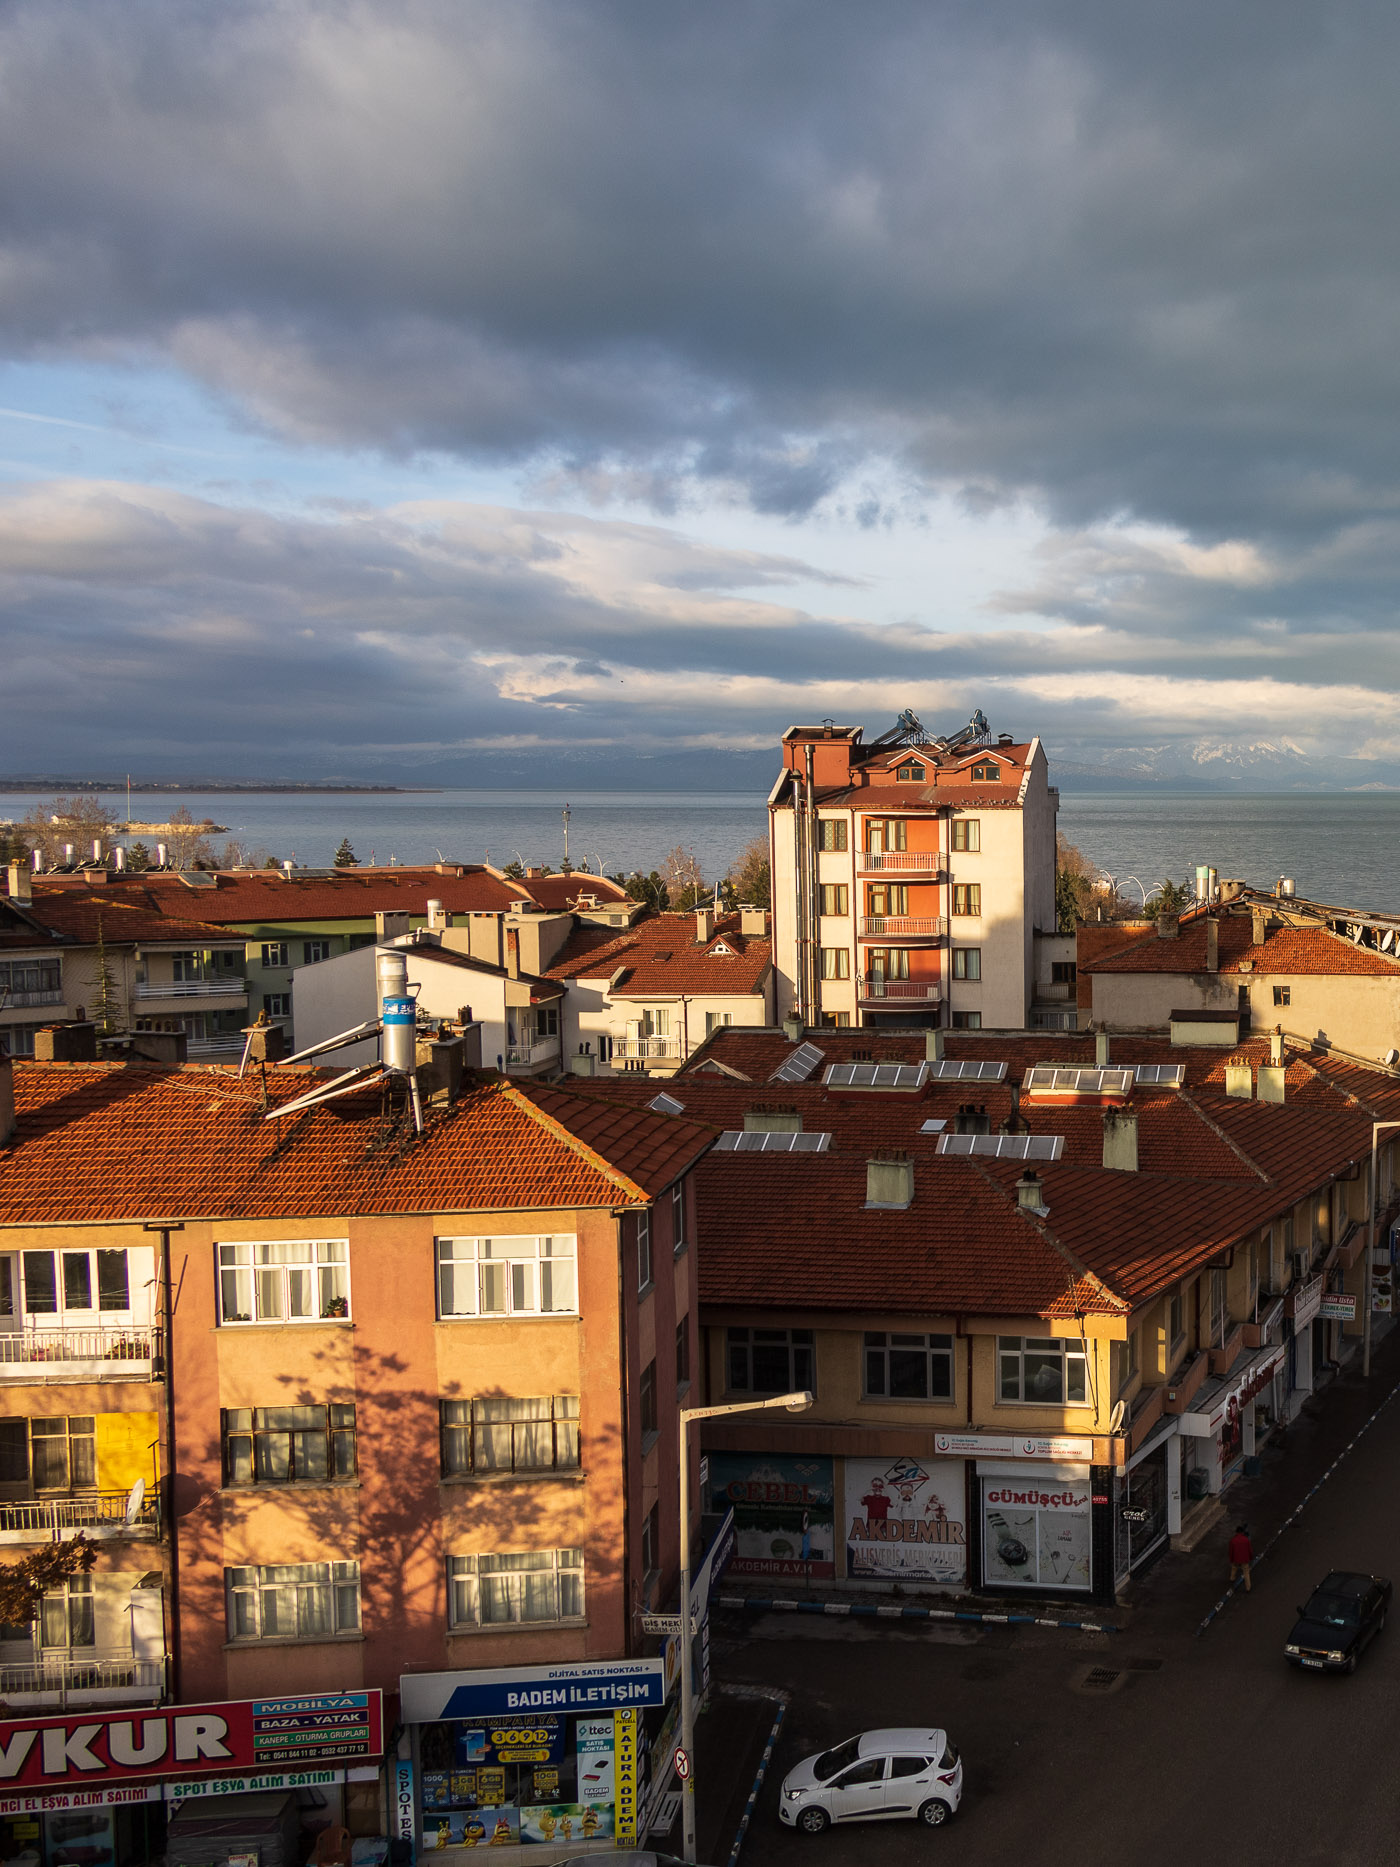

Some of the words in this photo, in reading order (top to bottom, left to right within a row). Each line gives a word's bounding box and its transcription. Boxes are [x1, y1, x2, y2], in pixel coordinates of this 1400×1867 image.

[727, 1480, 816, 1504] CEBEL
[988, 1489, 1074, 1507] GÜMÜŞÇÜ
[848, 1514, 966, 1544] AKDEMİR
[730, 1560, 780, 1572] AKDEMİR
[548, 1670, 580, 1678] DİJİTAL
[582, 1667, 605, 1676] SATIŞ
[606, 1666, 643, 1674] NOKTASI
[507, 1689, 566, 1708] BADEM
[570, 1684, 649, 1703] İLETİŞİM
[261, 1698, 354, 1713] MOBİLYA
[261, 1719, 300, 1729] BAZA
[313, 1713, 360, 1724] YATAK
[462, 1714, 558, 1727] KAMPANYA
[259, 1736, 289, 1745] KANEPE
[295, 1732, 328, 1742] OTURMA
[330, 1729, 366, 1739] GRUPLARI
[496, 1733, 502, 1742] 3
[510, 1733, 516, 1741] 6
[523, 1732, 530, 1740] 9
[535, 1732, 546, 1740] 12
[590, 1725, 612, 1735] ttec
[321, 1747, 336, 1755] 0532
[337, 1746, 347, 1754] 437
[621, 1726, 632, 1781] FATURA
[174, 1783, 208, 1796] SPOT
[213, 1780, 245, 1793] EŞYA
[250, 1775, 283, 1789] ALIM
[289, 1771, 335, 1785] SATIMI
[25, 1799, 38, 1810] EL
[42, 1796, 69, 1810] EŞYA
[73, 1792, 103, 1805] ALIM
[107, 1788, 148, 1802] SATIMI
[619, 1786, 634, 1833] ÖDEME
[616, 1836, 635, 1846] NOKTASI
